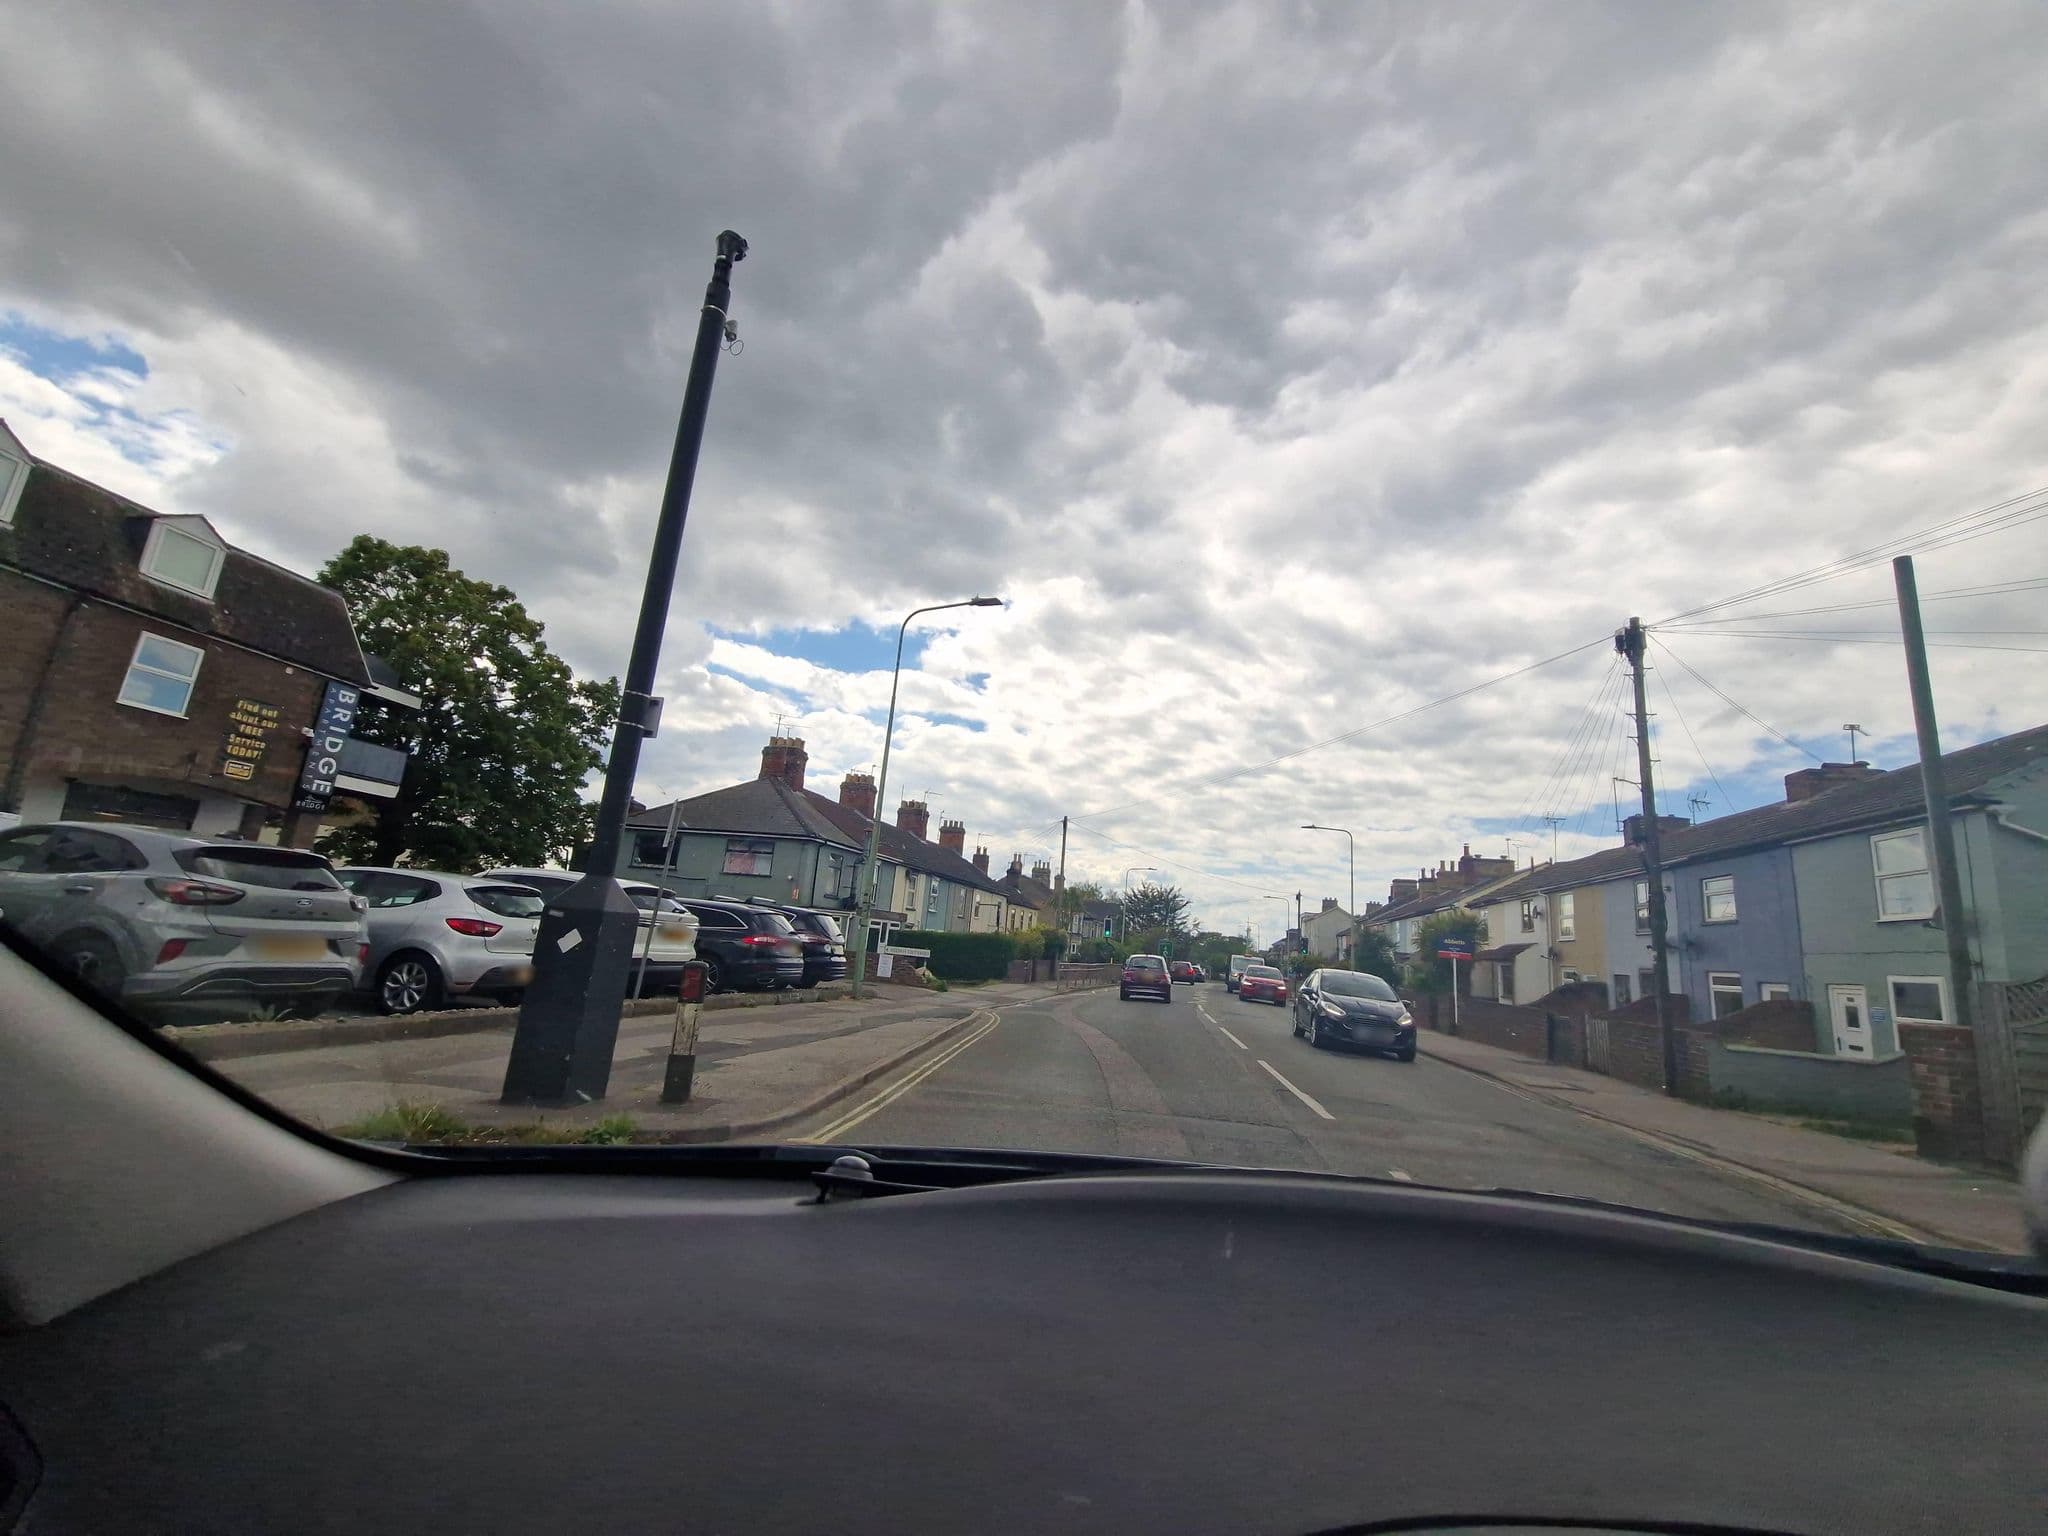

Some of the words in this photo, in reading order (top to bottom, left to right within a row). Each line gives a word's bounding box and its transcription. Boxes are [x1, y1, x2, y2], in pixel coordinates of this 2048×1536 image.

[237, 701, 259, 713] Find
[262, 709, 278, 718] out
[229, 712, 259, 725] about
[262, 720, 279, 729] our
[240, 725, 264, 736] FREE
[302, 687, 337, 790] APARTMENTS
[229, 733, 266, 749] Service
[312, 690, 356, 793] BRIDGE
[227, 745, 262, 760] TODAY!
